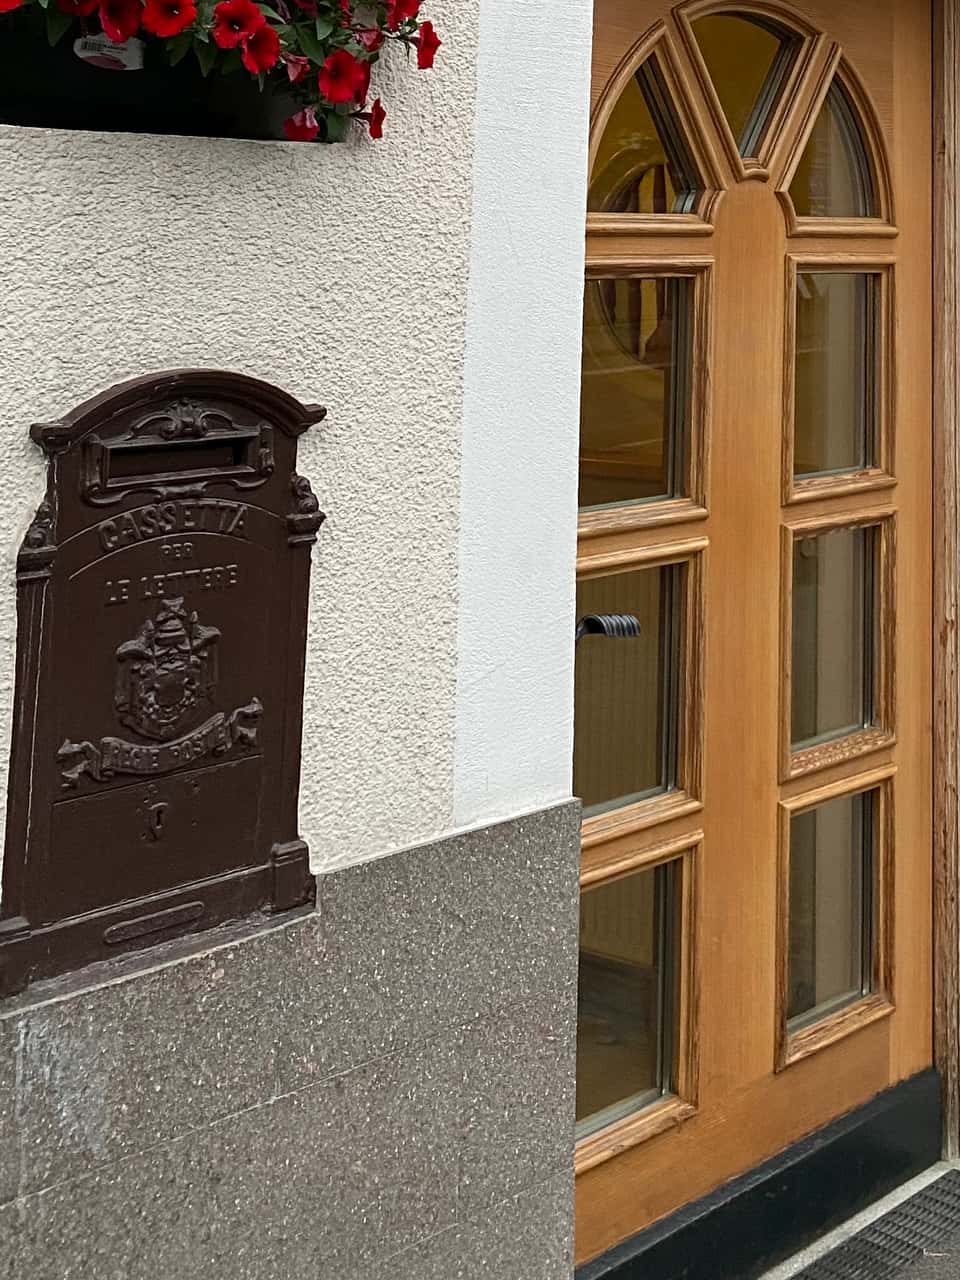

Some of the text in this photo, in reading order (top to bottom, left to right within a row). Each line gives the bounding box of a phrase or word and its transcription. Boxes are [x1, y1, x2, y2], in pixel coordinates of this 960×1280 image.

[99, 501, 249, 550] CASSETTA
[104, 564, 239, 605] LE LETTERE
